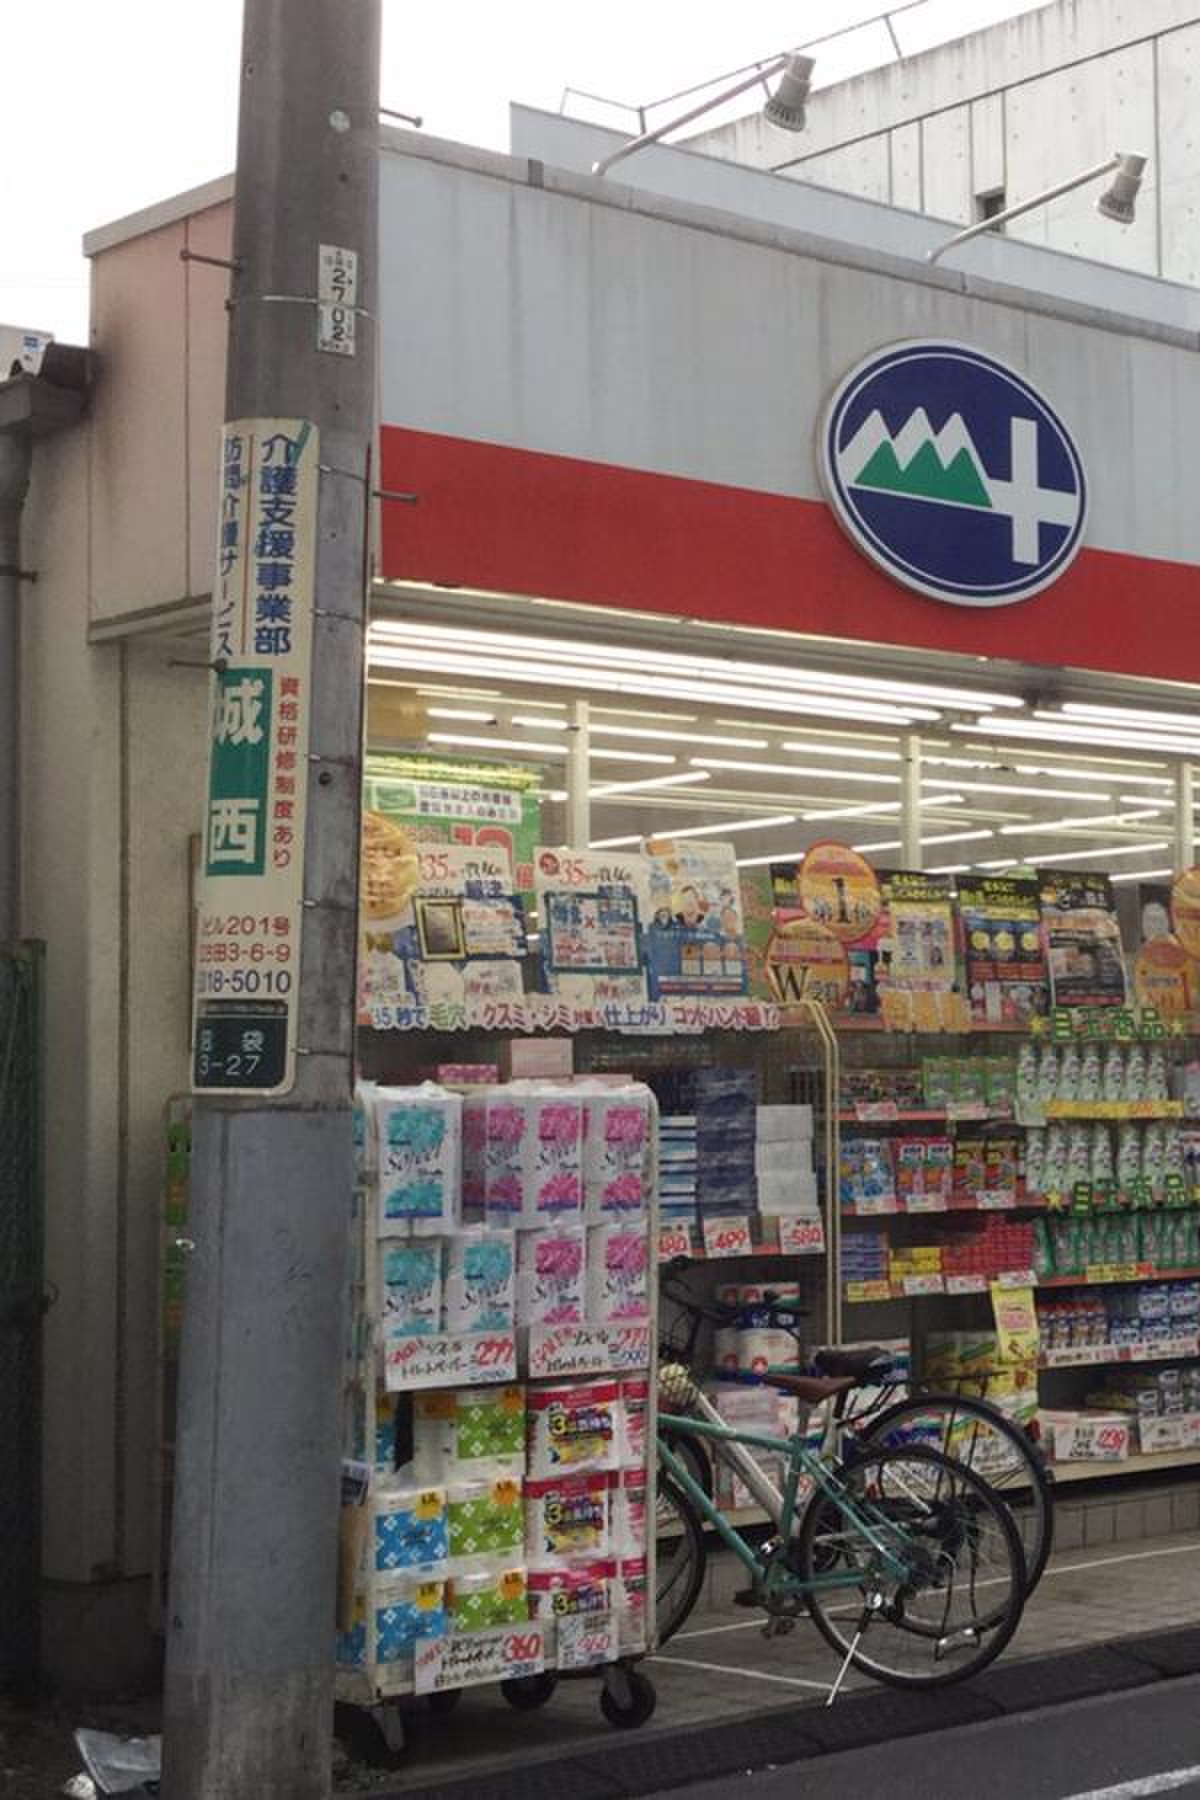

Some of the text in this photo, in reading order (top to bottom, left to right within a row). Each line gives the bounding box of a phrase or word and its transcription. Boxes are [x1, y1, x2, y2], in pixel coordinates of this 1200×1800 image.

[331, 267, 346, 342] 2702
[254, 433, 298, 656] 介護支援事業部
[208, 678, 265, 866] 城西
[272, 676, 300, 869] 資格研修制度あり
